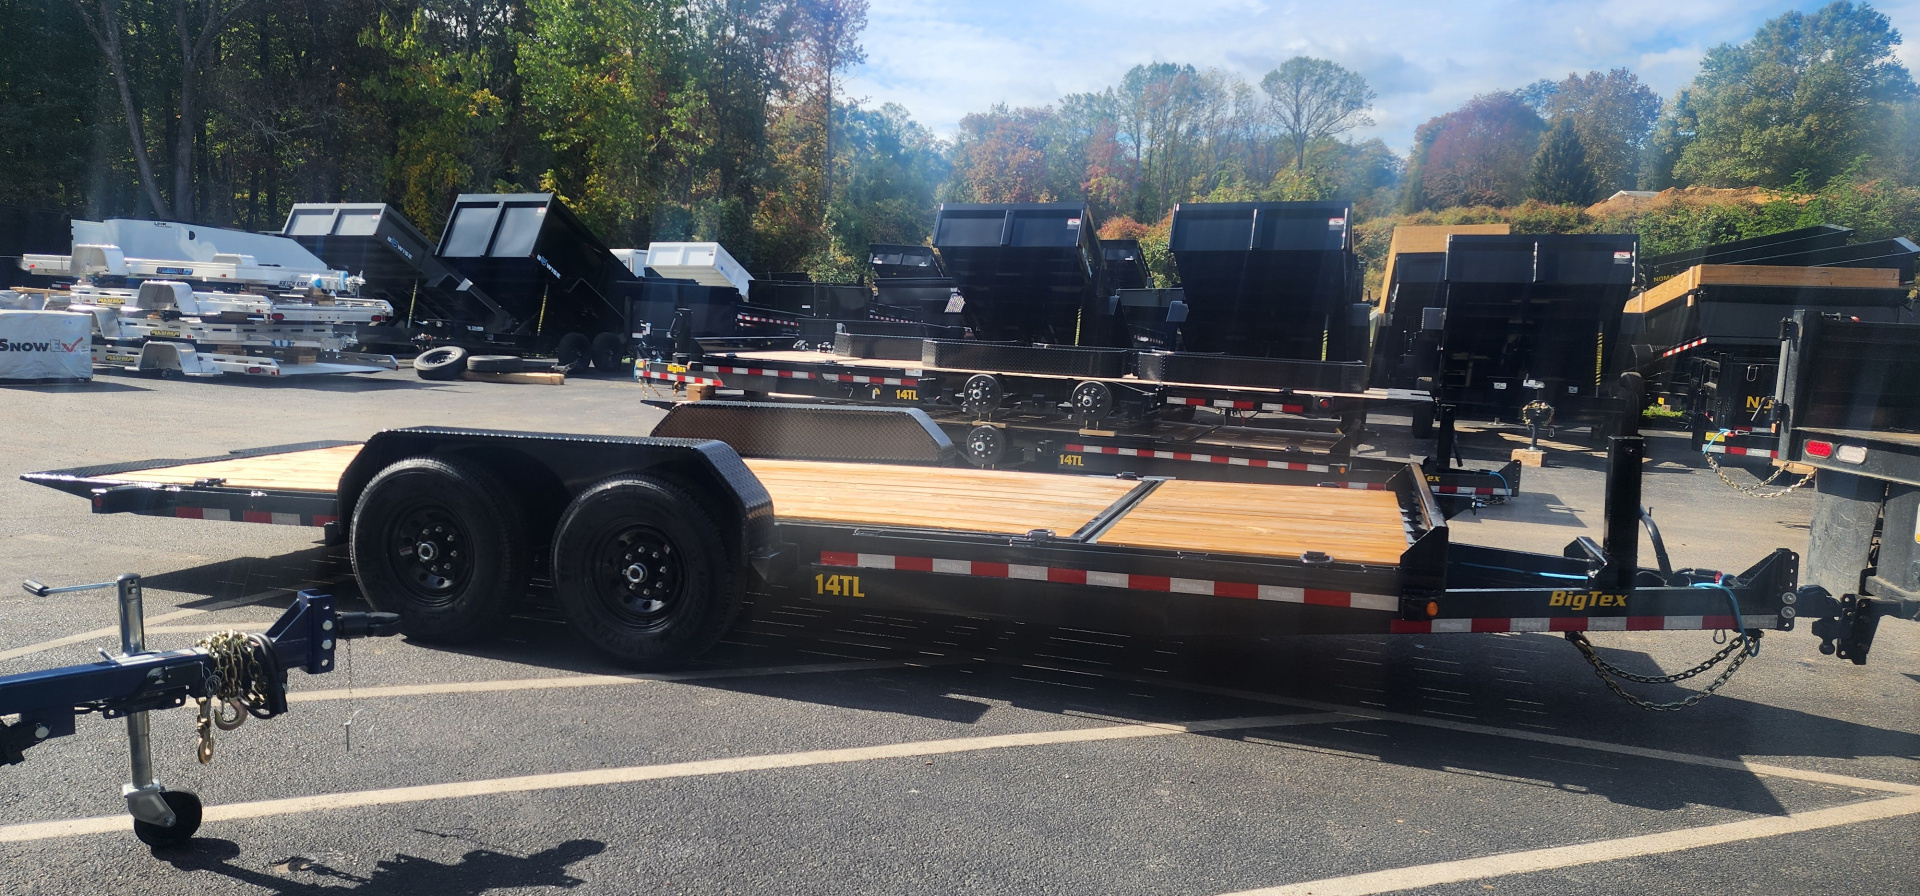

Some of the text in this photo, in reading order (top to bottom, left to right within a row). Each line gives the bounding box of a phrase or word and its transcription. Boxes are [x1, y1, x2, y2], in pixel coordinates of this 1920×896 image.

[150, 329, 180, 337] ALUMA
[896, 389, 919, 400] 14TL
[1060, 454, 1085, 466] 14TL
[815, 573, 866, 598] 14TL
[1549, 590, 1628, 611] BigTex
